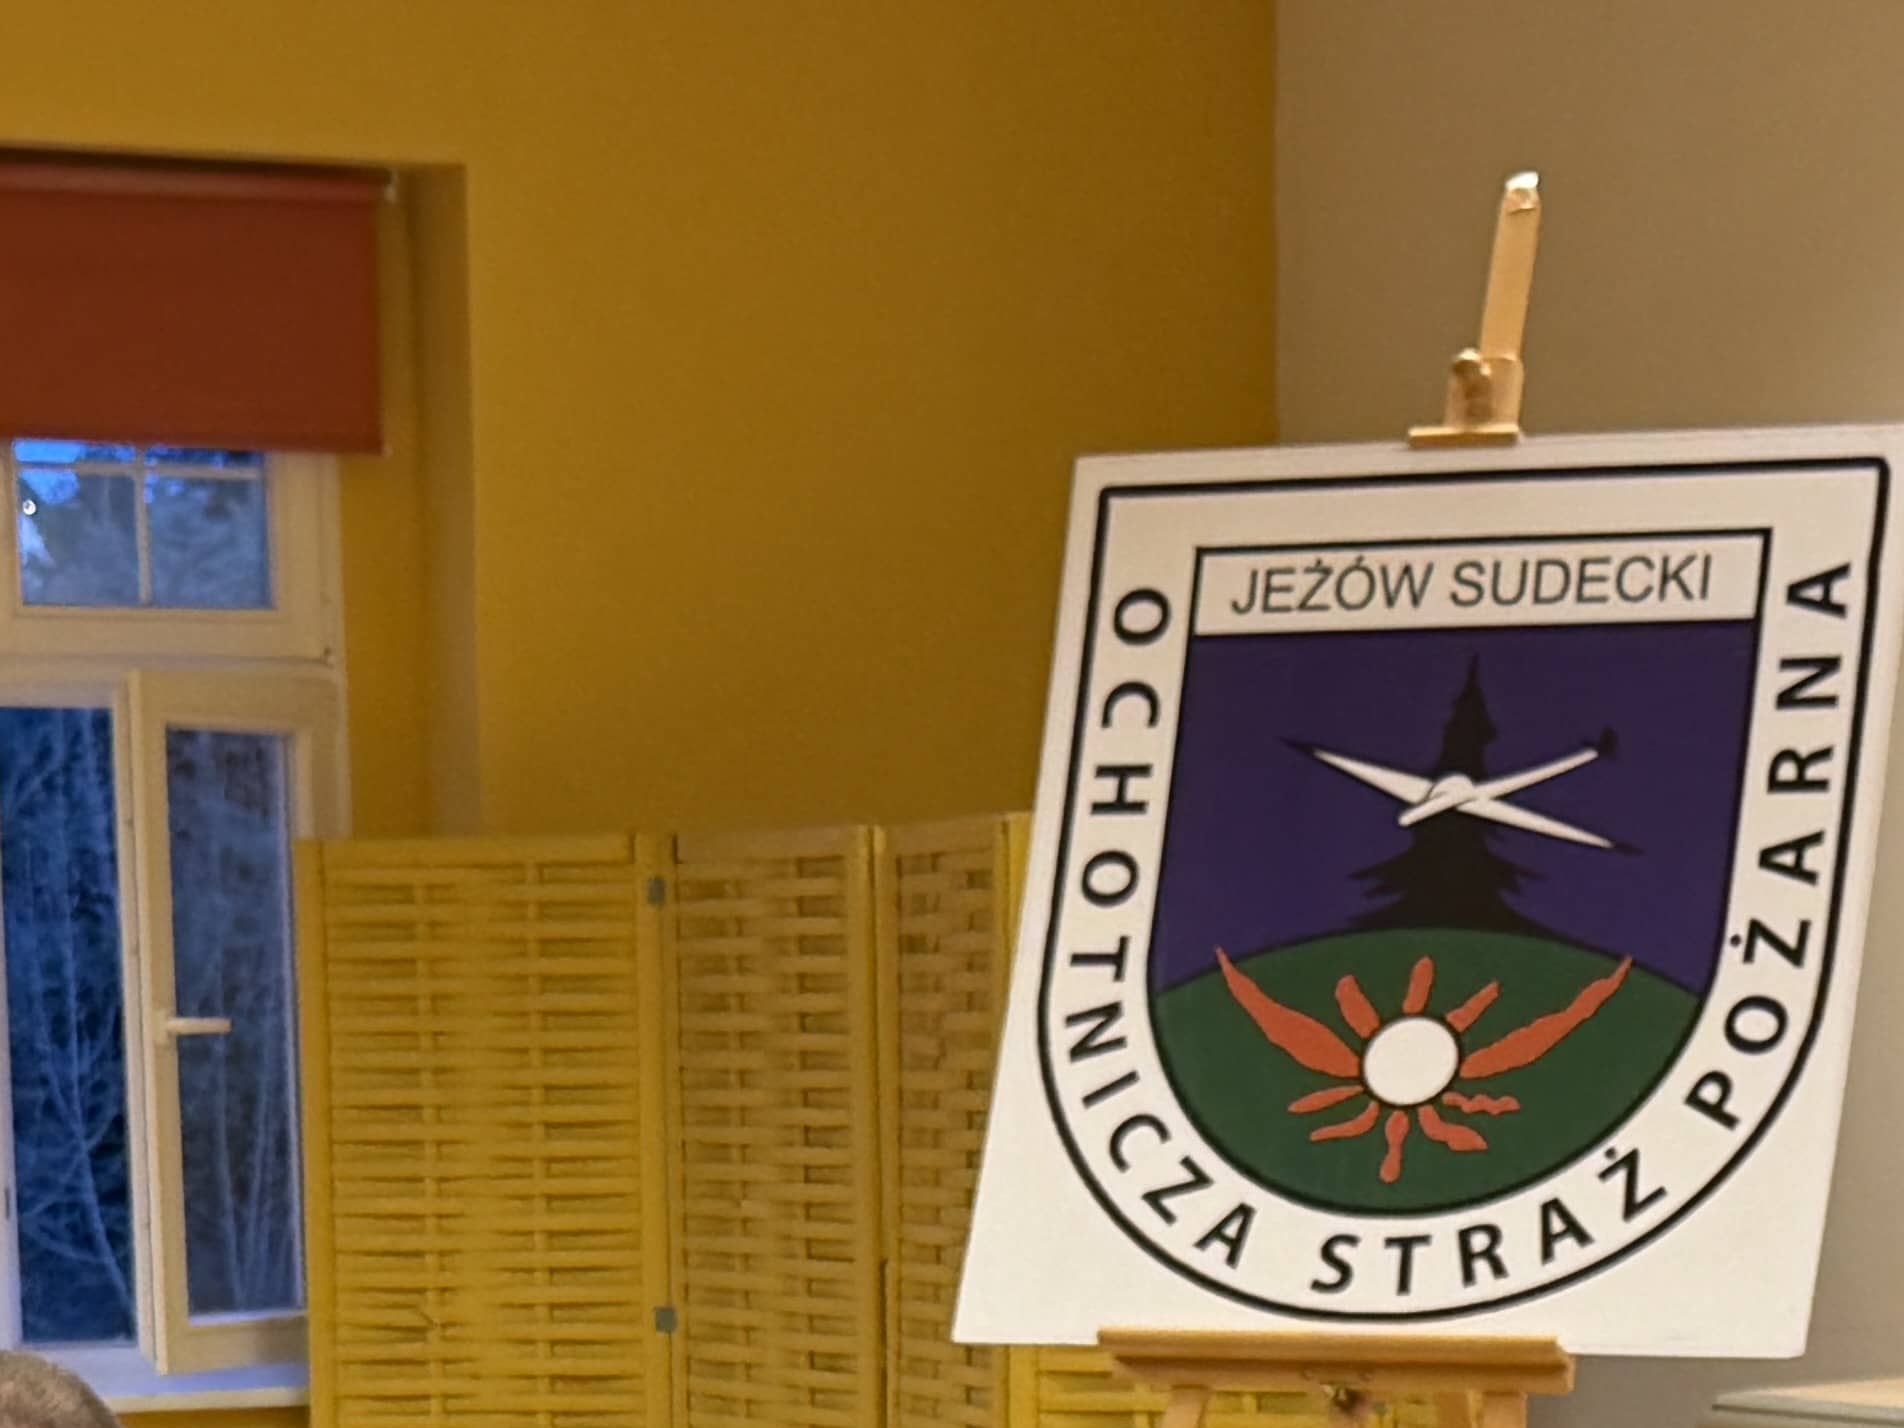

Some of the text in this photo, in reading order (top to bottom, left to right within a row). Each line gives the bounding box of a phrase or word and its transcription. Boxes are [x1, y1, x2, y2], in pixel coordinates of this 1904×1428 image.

[1232, 554, 1713, 615] JEŻÓW SUDECKI
[1063, 560, 1851, 1297] OCHOTNICZA STRAŻ POŻARNA
